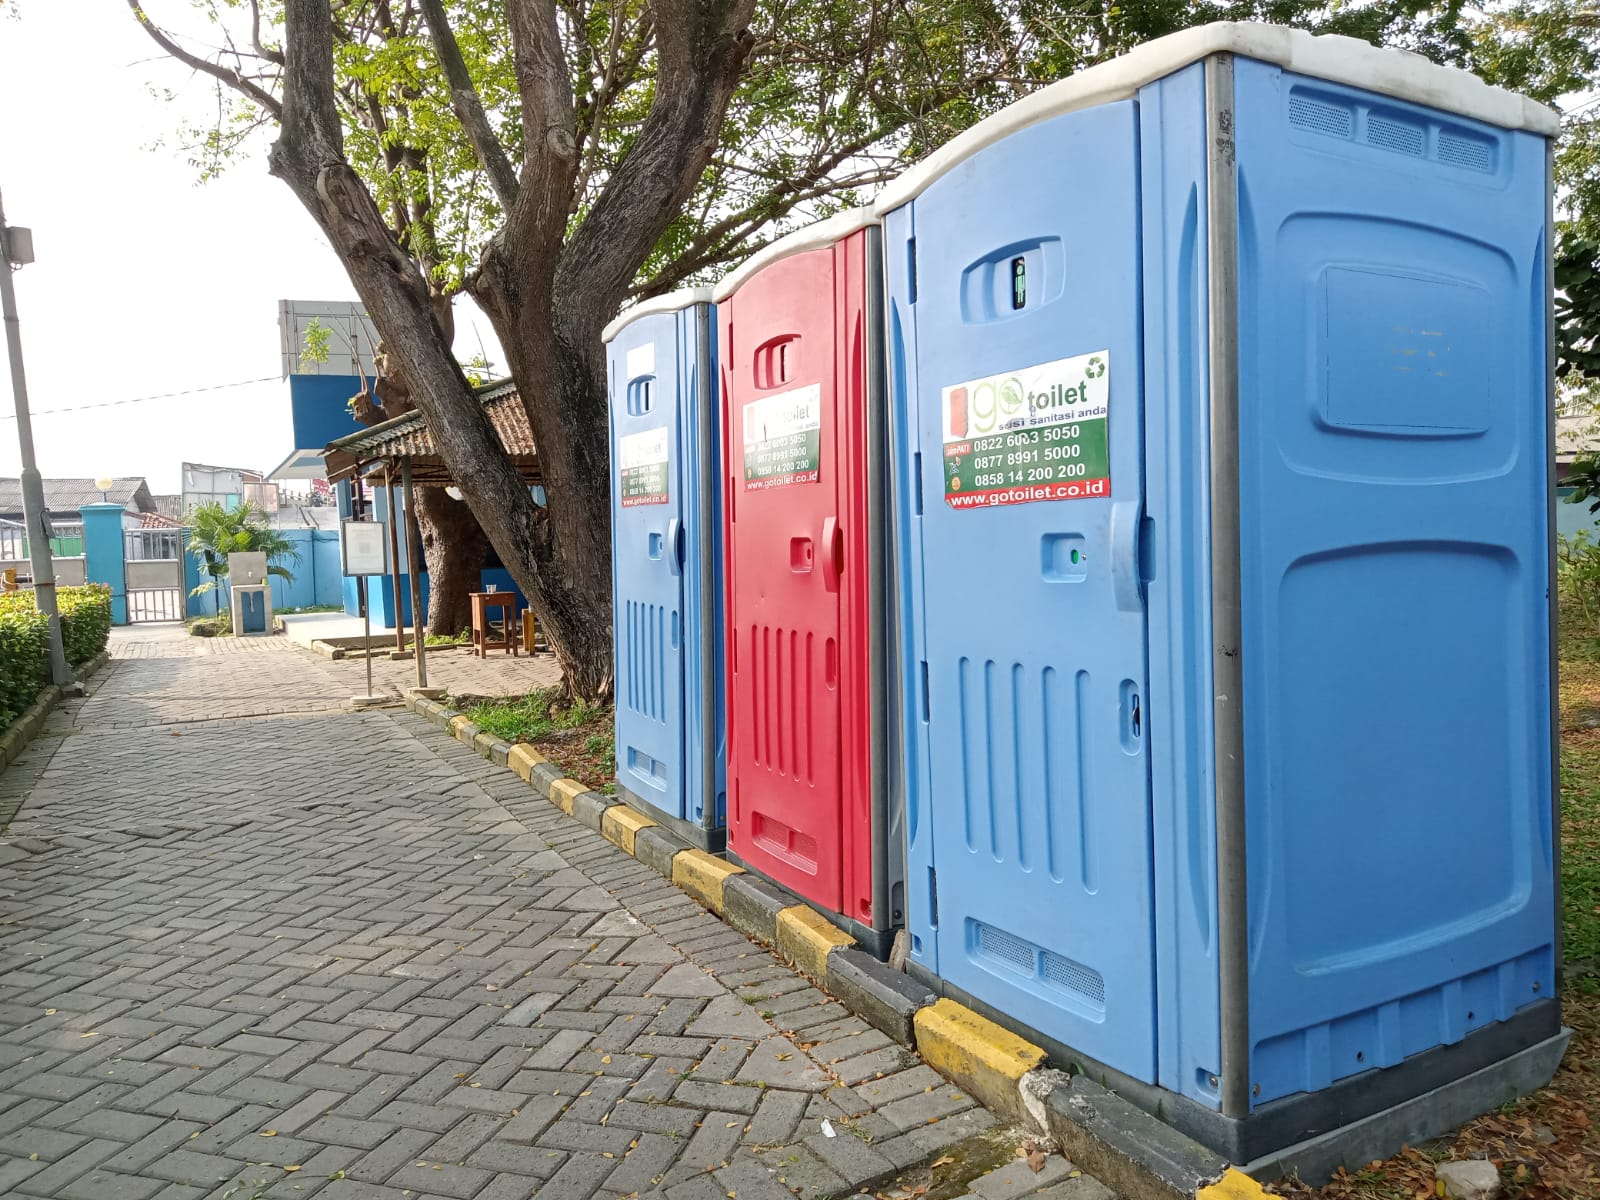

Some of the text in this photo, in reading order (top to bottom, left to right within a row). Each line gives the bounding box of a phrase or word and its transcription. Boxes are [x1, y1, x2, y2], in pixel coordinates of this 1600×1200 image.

[1027, 380, 1088, 410] toilet
[1029, 410, 1075, 426] sanitasi
[1078, 406, 1107, 418] anda
[974, 425, 1080, 452] 0822 6003 5050
[782, 462, 795, 472] 200
[796, 459, 809, 469] 200
[974, 444, 1081, 470] 0877 8991 5000
[975, 463, 1086, 487] 0858 14 200 200
[951, 480, 1104, 506] www.gotoilet.co.id
